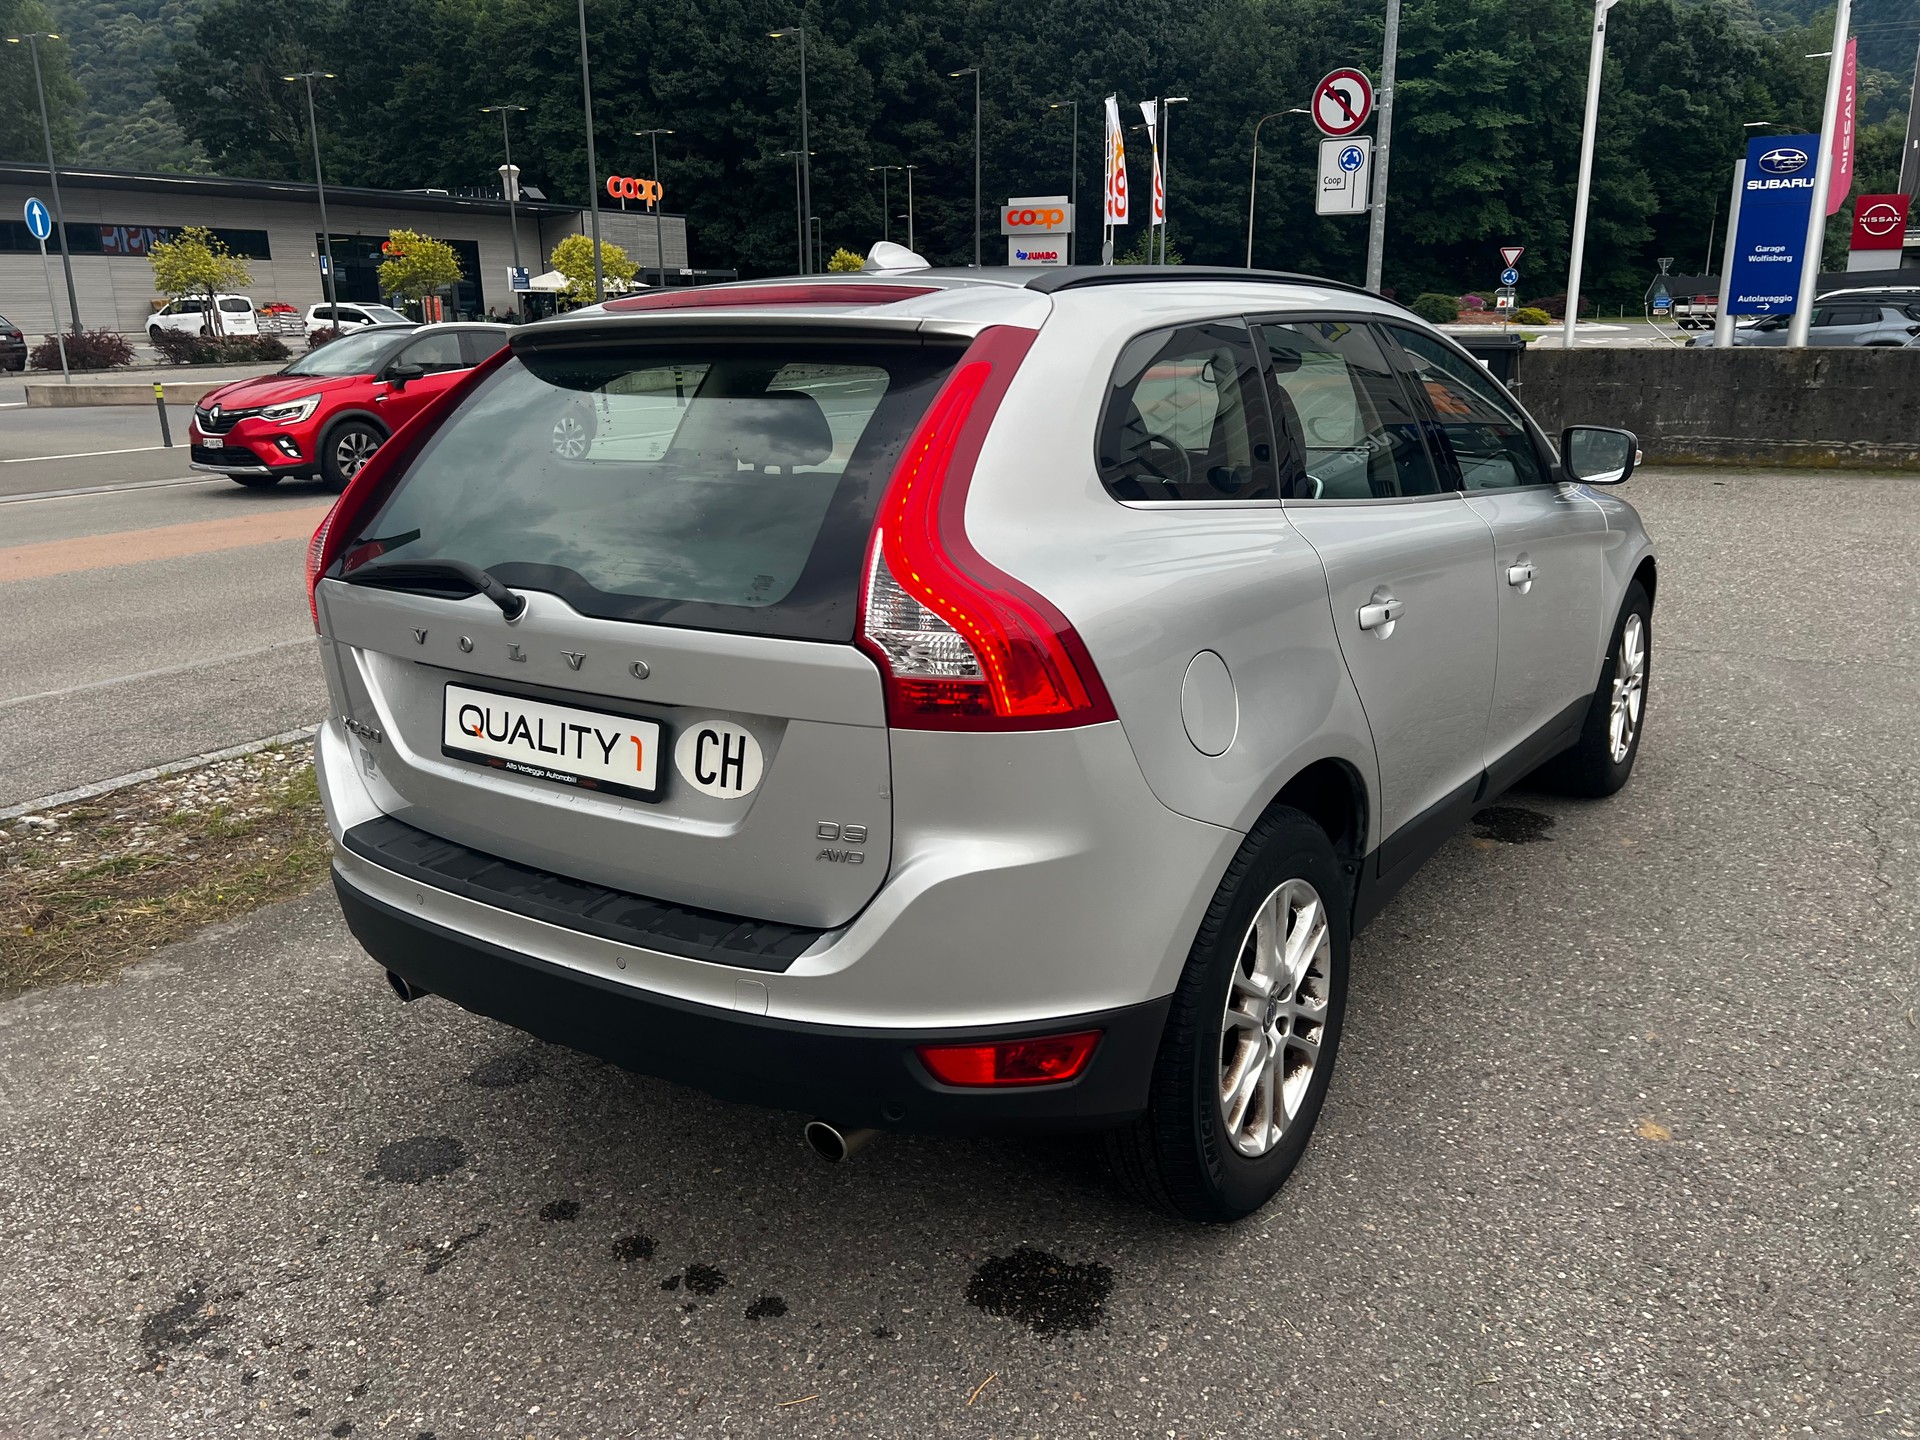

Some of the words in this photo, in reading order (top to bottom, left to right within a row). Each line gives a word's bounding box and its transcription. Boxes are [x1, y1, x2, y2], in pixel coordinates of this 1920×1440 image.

[1841, 86, 1853, 174] NISSAN
[1323, 176, 1342, 186] Coop
[1746, 177, 1815, 190] SUBARU
[606, 175, 663, 207] coop
[1006, 208, 1064, 229] coop
[1027, 251, 1058, 260] JUMBO
[1755, 245, 1786, 253] Garage
[1748, 255, 1793, 263] Wolfisberg
[1737, 294, 1793, 303] Autolavaggio
[410, 626, 650, 680] VOLVO
[458, 703, 621, 765] QUALITY
[505, 761, 518, 770] Alto
[694, 728, 747, 792] CH
[816, 820, 868, 844] D3
[816, 848, 865, 864] AWD
